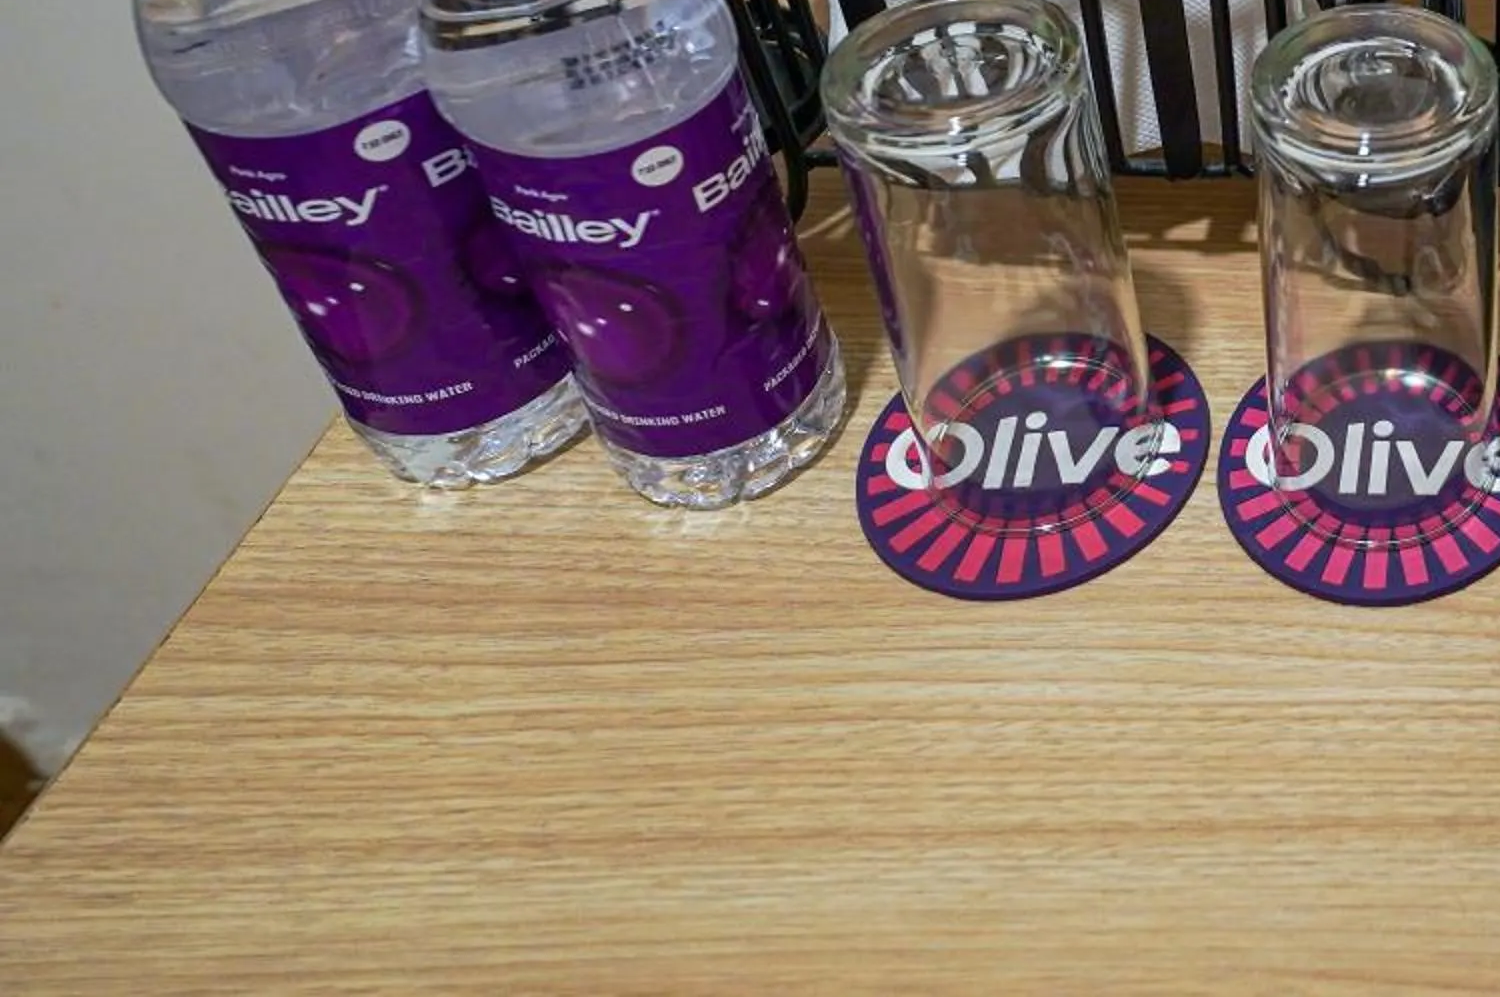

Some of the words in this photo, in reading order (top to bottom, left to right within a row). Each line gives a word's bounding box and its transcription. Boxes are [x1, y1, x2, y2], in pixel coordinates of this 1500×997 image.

[226, 187, 379, 226] ailley
[489, 196, 653, 248] Bailley
[425, 381, 474, 402] WATER
[681, 405, 727, 424] WATER
[884, 411, 1181, 491] Olive
